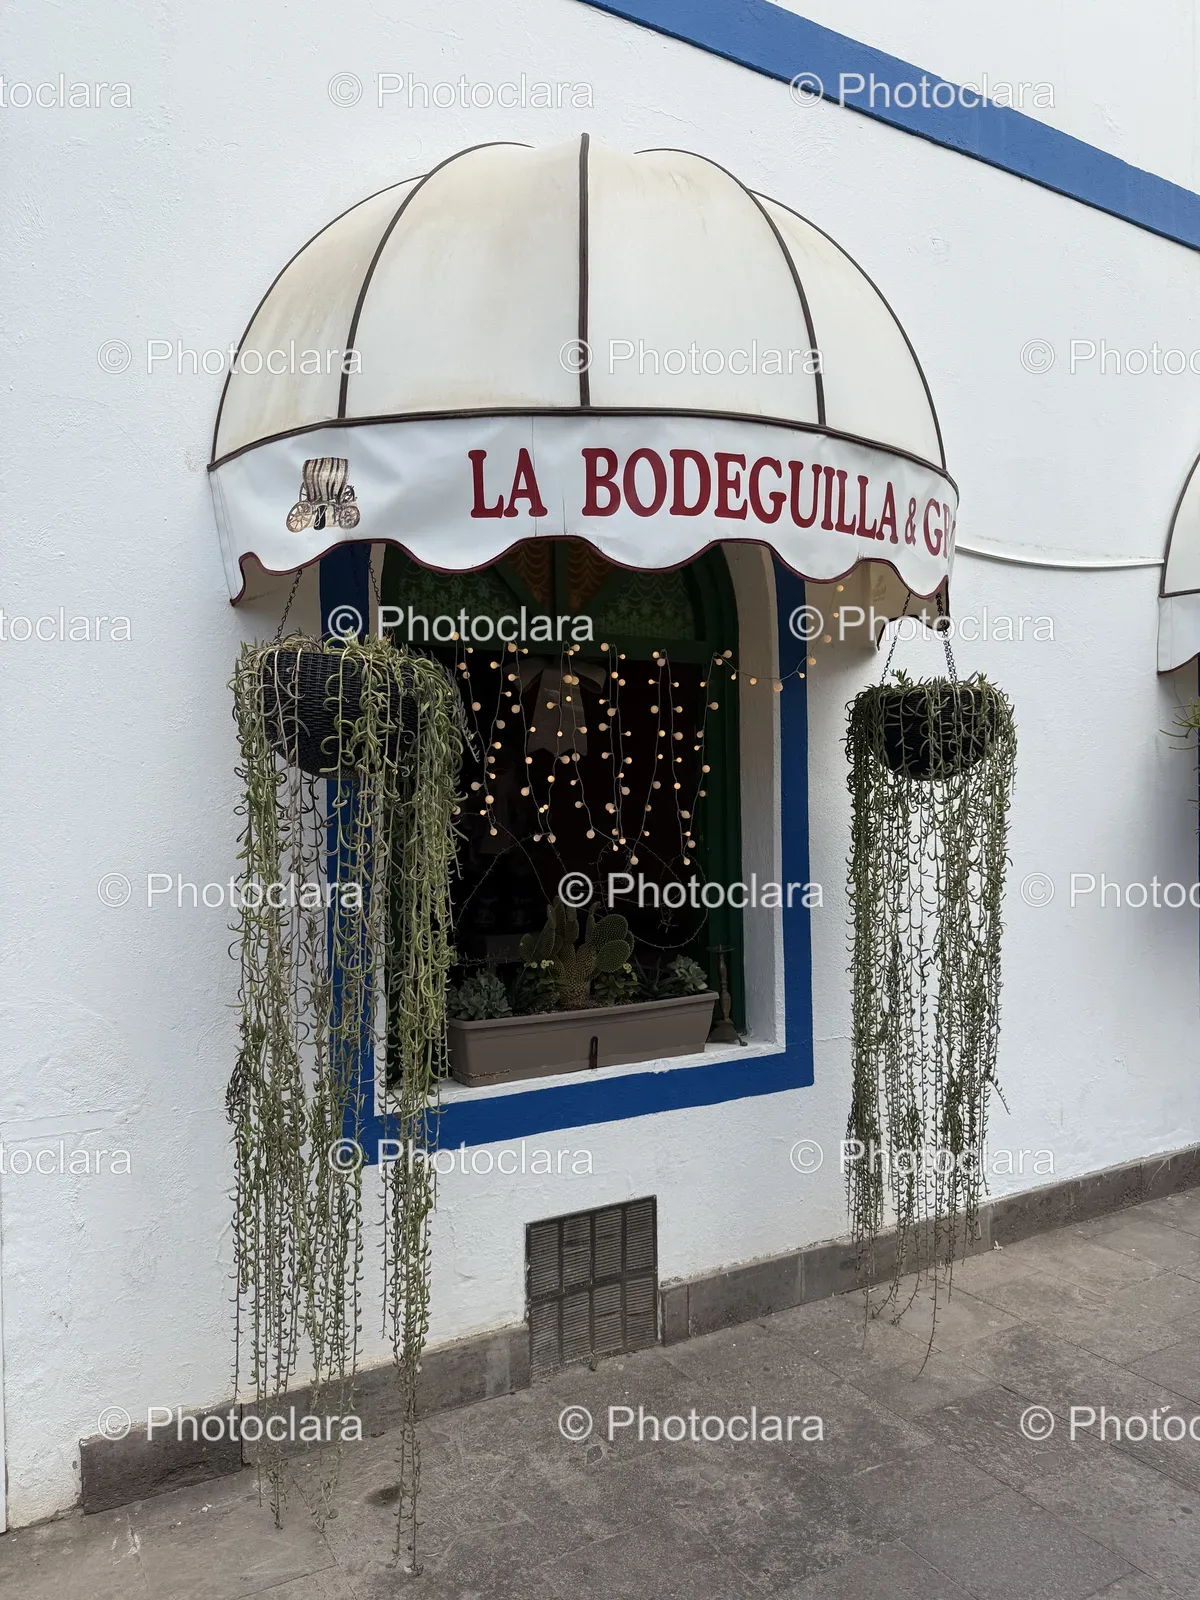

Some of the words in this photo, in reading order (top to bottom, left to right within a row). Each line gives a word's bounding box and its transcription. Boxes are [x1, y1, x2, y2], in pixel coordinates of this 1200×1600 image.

[468, 448, 548, 518] LA
[581, 447, 899, 545] BODEGUILLA
[904, 497, 917, 546] &
